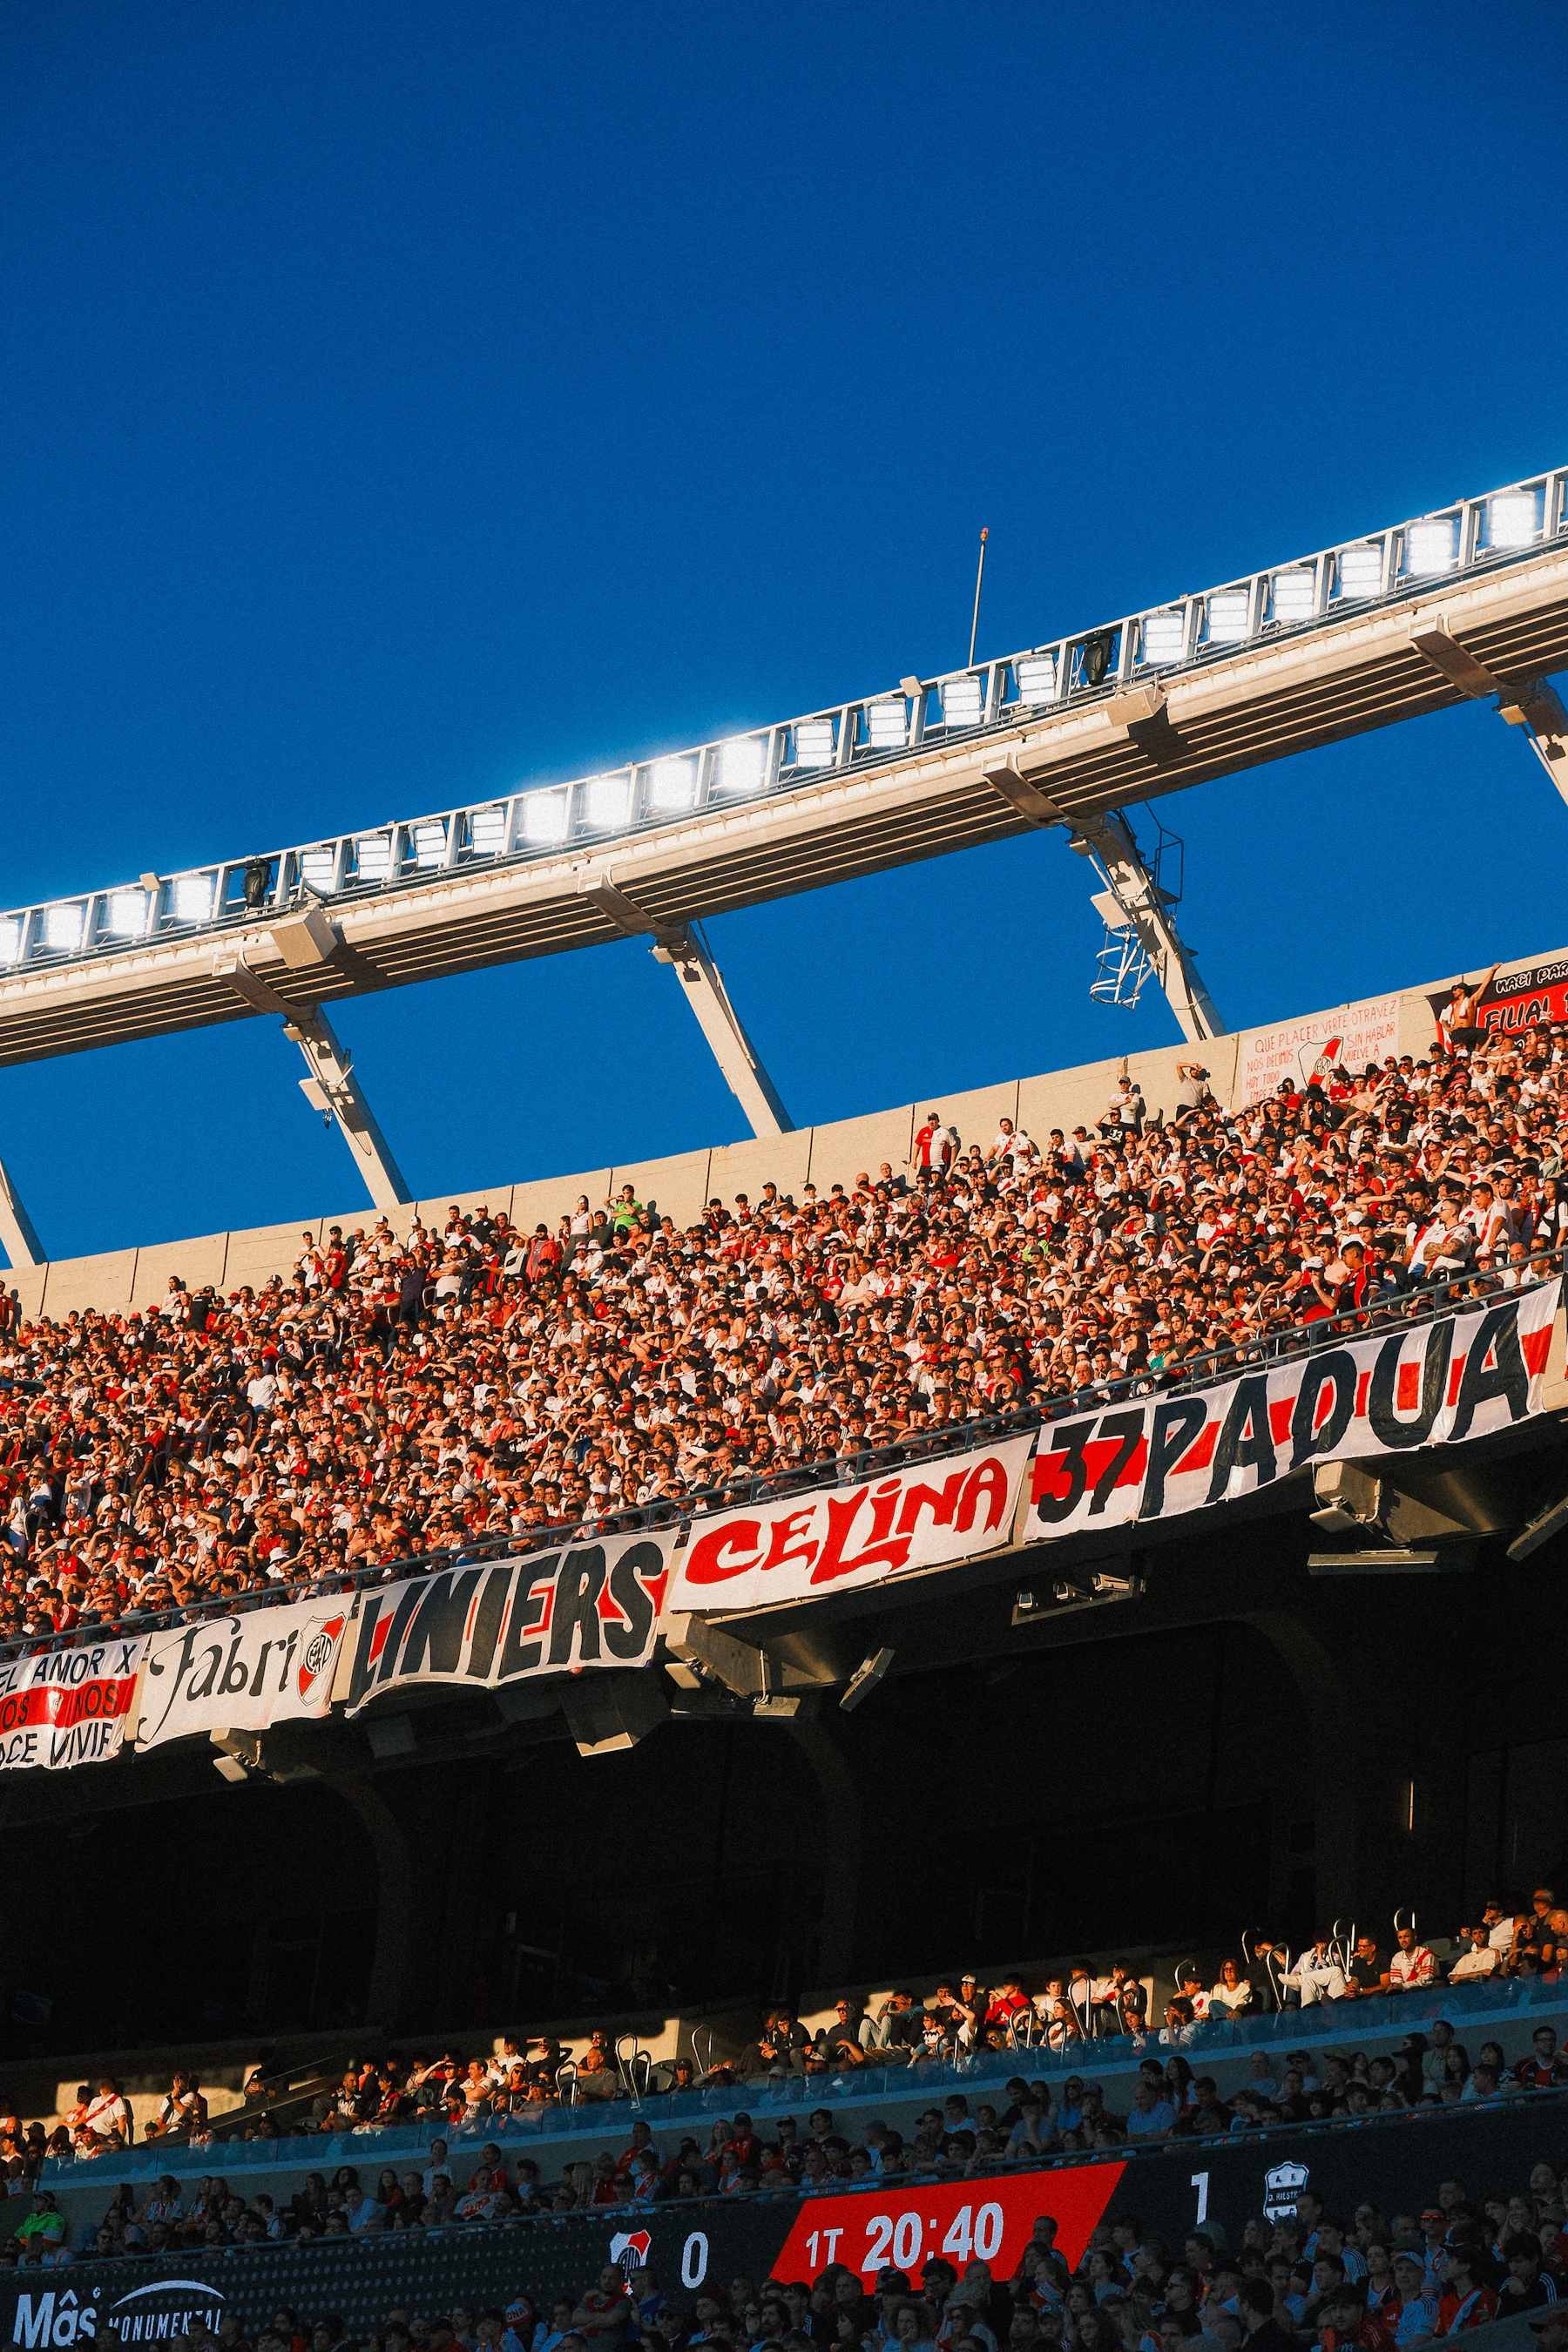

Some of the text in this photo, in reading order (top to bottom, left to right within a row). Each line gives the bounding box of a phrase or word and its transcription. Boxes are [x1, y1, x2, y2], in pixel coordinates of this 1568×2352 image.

[1496, 971, 1531, 993] NACI
[1255, 1037, 1275, 1053] QUE
[1279, 1024, 1319, 1047] PLACER
[1321, 1013, 1347, 1034] VERTE
[1347, 1021, 1396, 1048] SIN HABLAR
[1484, 996, 1553, 1034] FILIAL
[1247, 1048, 1294, 1073] NOS DECIMOS
[1342, 1044, 1380, 1062] VUELVE A
[1246, 1071, 1280, 1089] HOY TODO
[1037, 1299, 1530, 1524] 37 PADUA
[349, 1541, 665, 1708] LINIERS
[31, 1648, 105, 1685] AMOR
[114, 1644, 137, 1674] X
[136, 1616, 300, 1744] Fabri
[0, 1685, 119, 1730] OS NOS
[1191, 2172, 1209, 2225] 1
[806, 2202, 1004, 2272] 1T 20:40
[681, 2232, 709, 2289] 0
[108, 2308, 221, 2342] ONUMENAL
